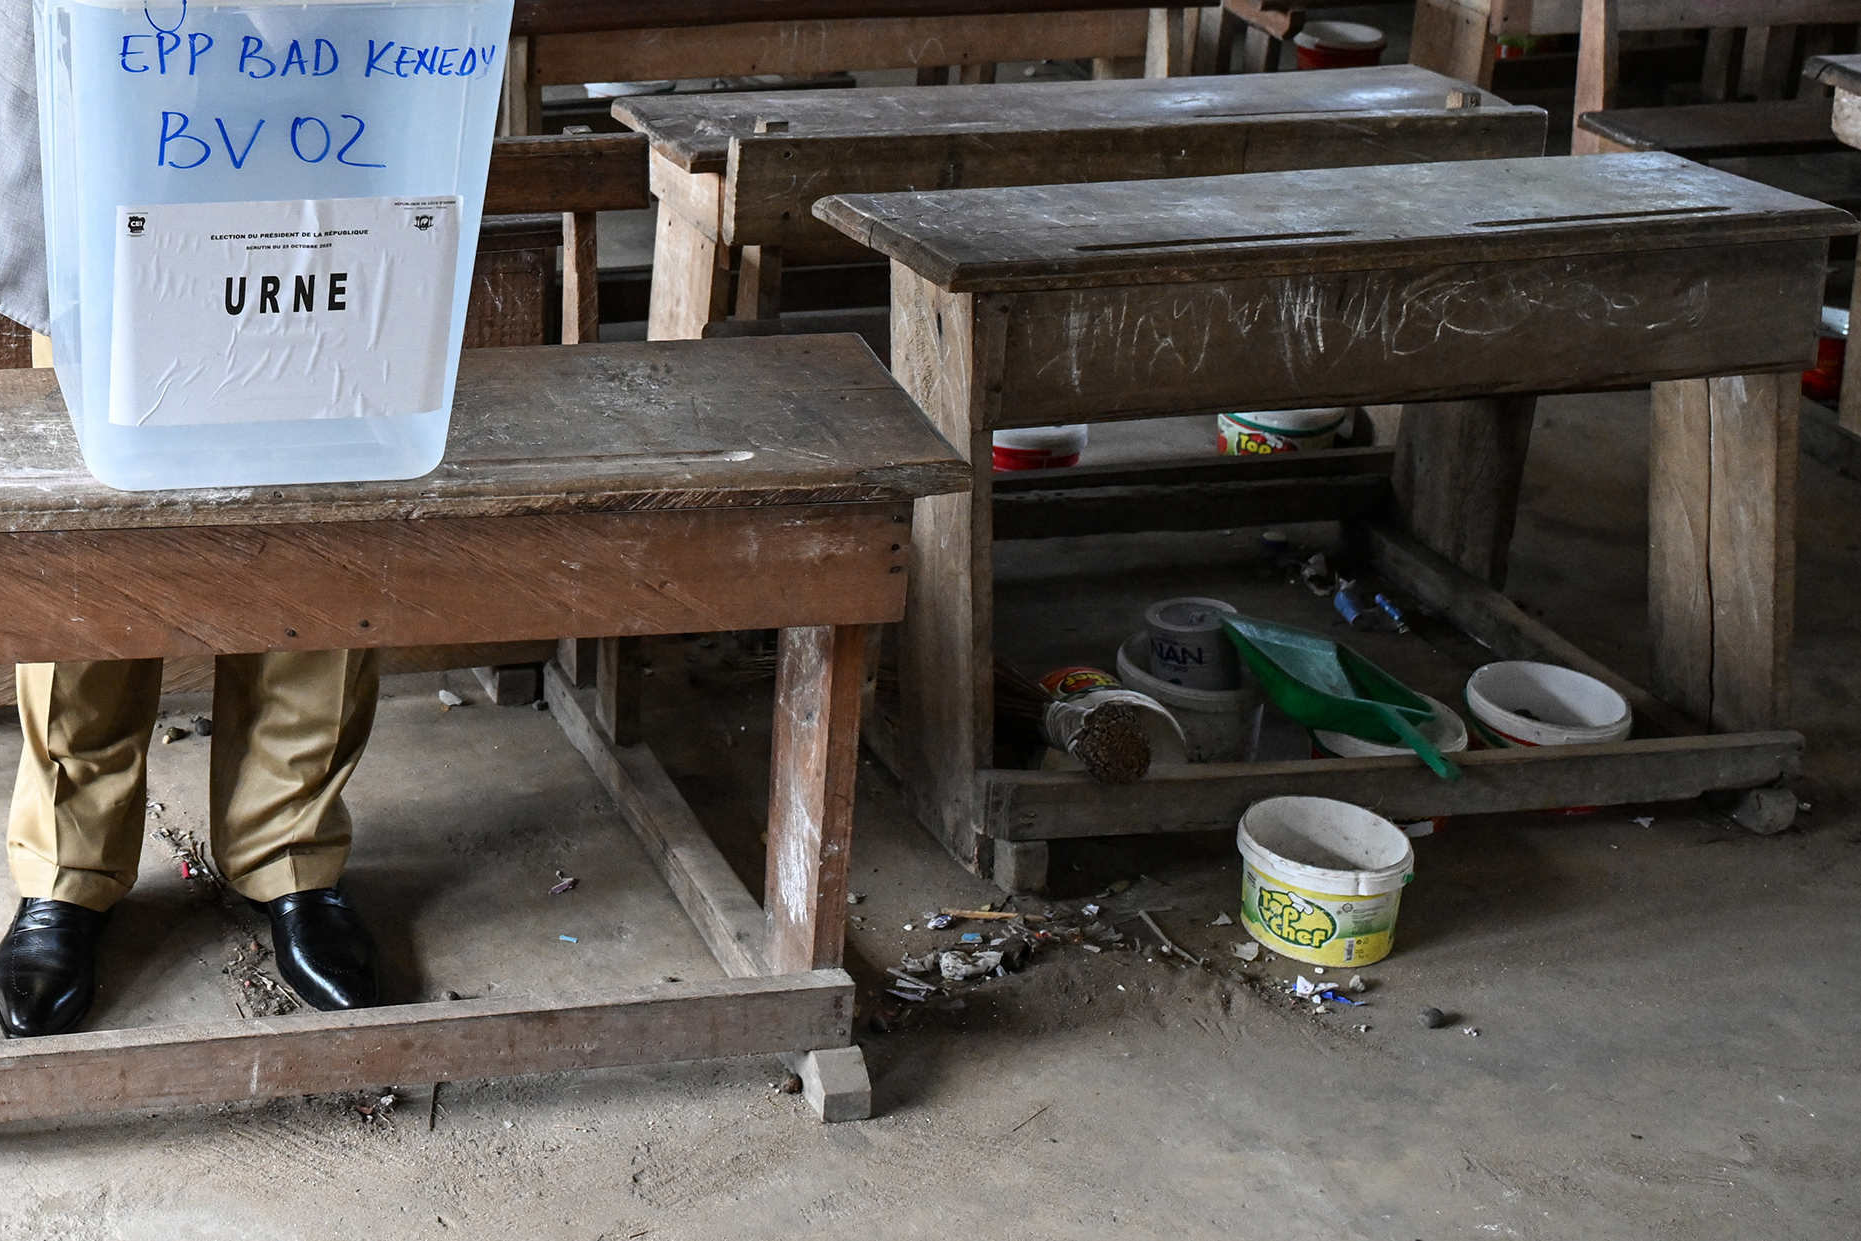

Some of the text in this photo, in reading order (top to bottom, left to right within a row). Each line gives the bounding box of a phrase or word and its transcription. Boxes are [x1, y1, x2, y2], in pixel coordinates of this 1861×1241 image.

[119, 32, 214, 76] EPP
[239, 35, 339, 79] BAD
[157, 111, 265, 170] BV
[260, 231, 300, 239] PRÉSIDENT
[324, 229, 369, 237] RÉPUBLIQUE
[225, 273, 348, 316] URNE
[1150, 638, 1203, 665] NAN
[1261, 889, 1300, 923] Top
